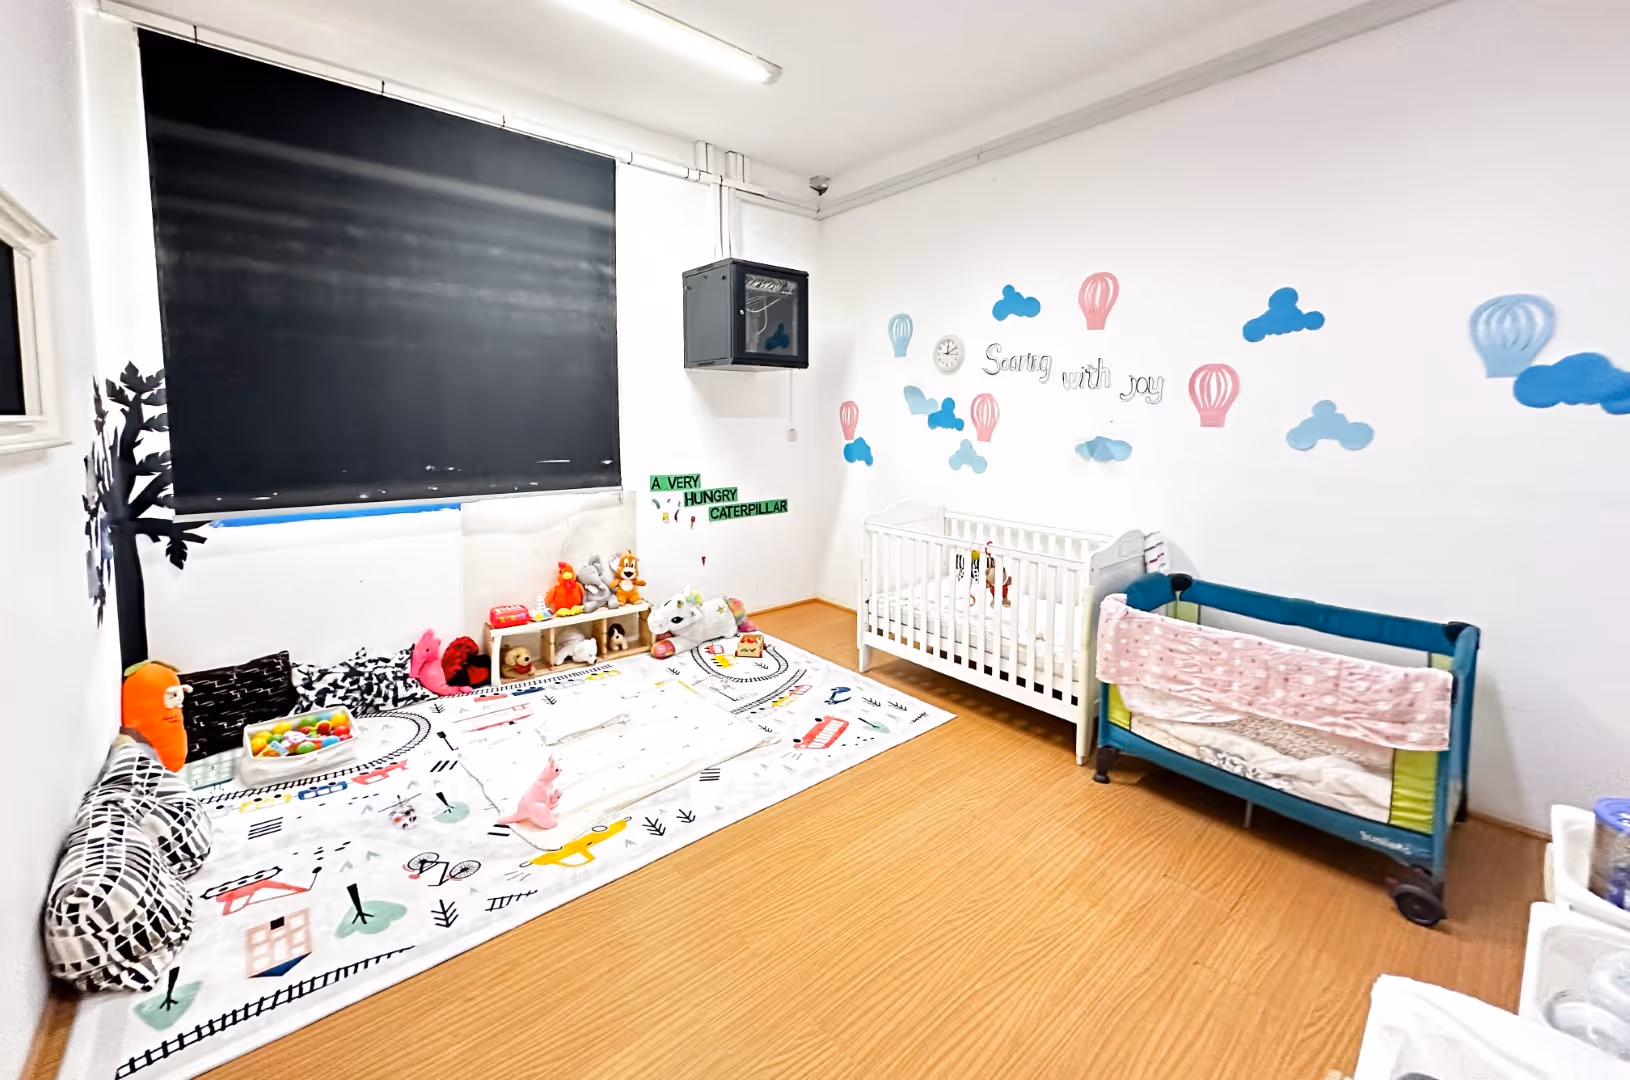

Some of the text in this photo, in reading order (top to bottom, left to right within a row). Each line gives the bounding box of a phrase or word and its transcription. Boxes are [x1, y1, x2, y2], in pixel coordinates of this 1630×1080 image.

[982, 343, 1165, 405] Soaring with joy
[651, 475, 700, 490] A VERY
[684, 488, 738, 507] HUNGRY
[710, 500, 787, 520] CATERPILLAR
